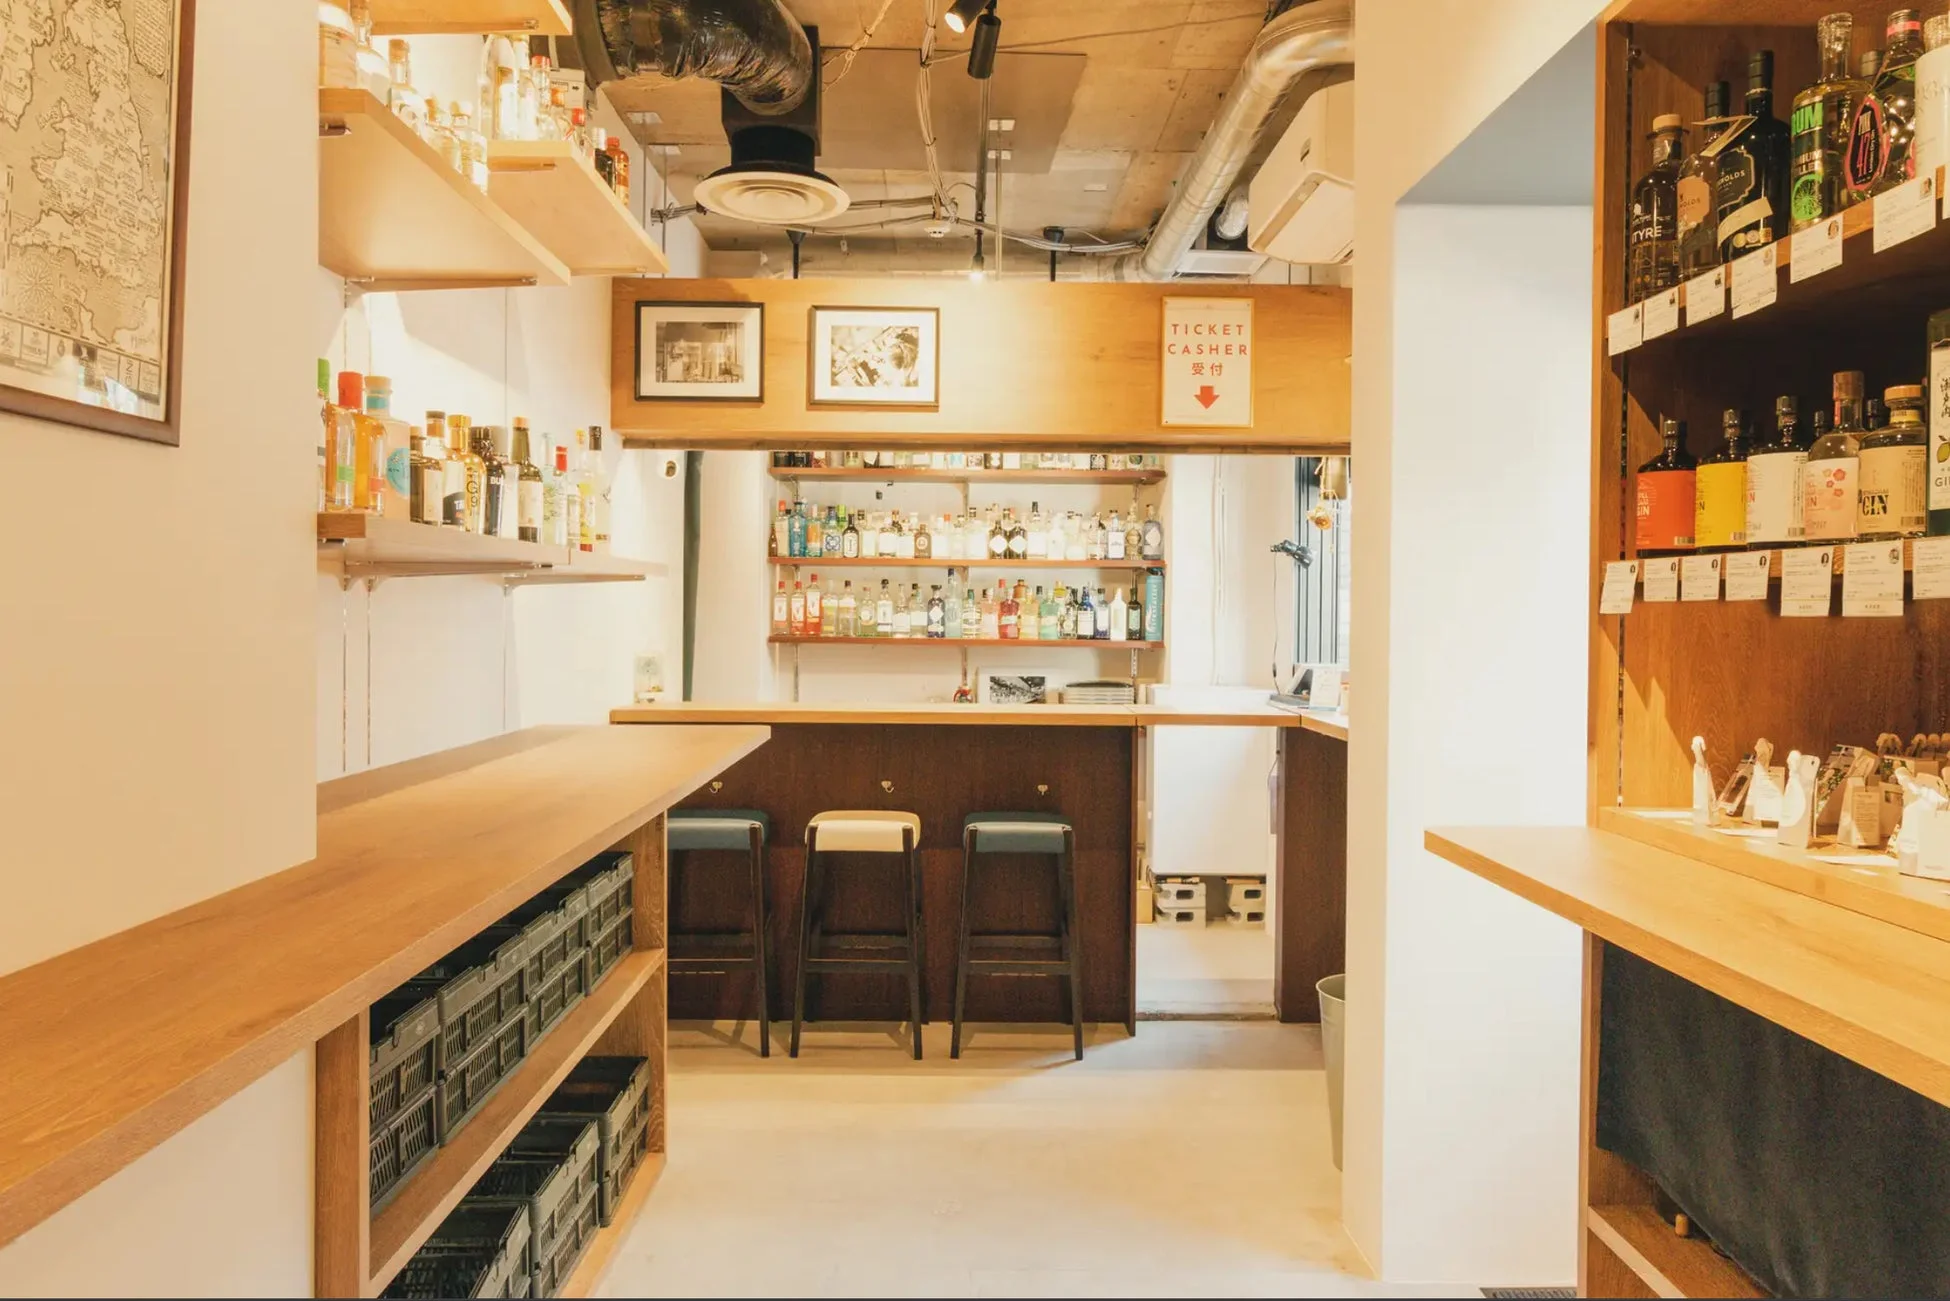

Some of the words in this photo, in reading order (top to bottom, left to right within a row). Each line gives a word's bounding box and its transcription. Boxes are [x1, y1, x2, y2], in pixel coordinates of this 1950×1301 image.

[1171, 324, 1244, 336] TICKET
[1167, 344, 1248, 356] CASHER
[1191, 362, 1223, 377] 受付
[1935, 476, 1950, 488] GI
[1862, 494, 1889, 516] GIN
